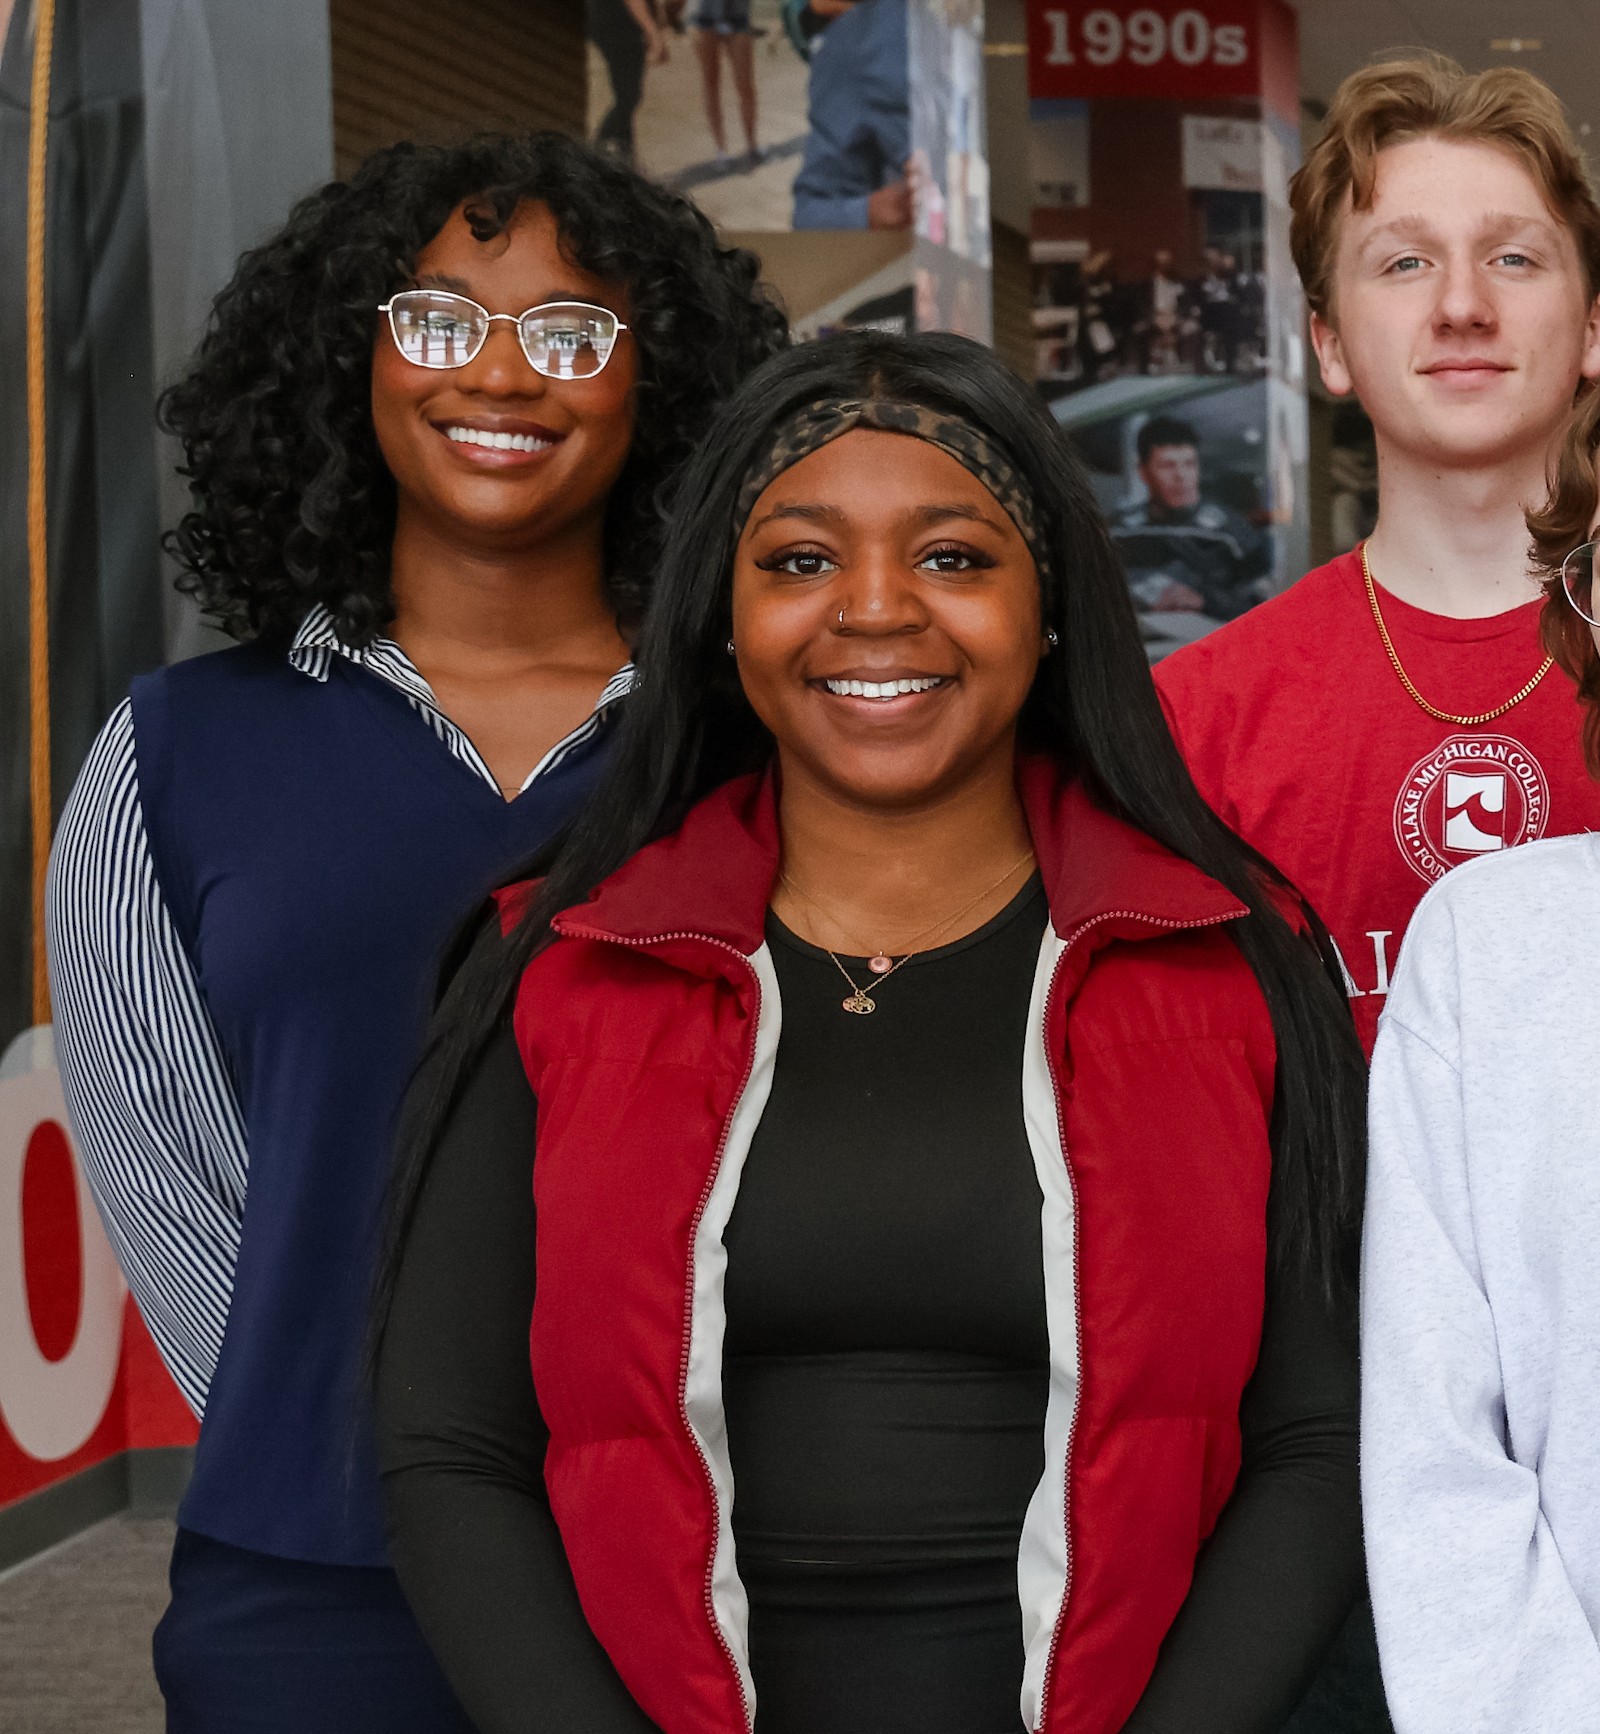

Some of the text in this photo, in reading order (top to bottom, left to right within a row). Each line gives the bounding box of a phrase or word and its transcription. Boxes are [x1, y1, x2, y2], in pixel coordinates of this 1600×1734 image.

[1044, 9, 1249, 66] 1990s
[1402, 743, 1541, 841] LAKE MICHIGAN COLLEGE
[1413, 847, 1446, 879] FOUN
